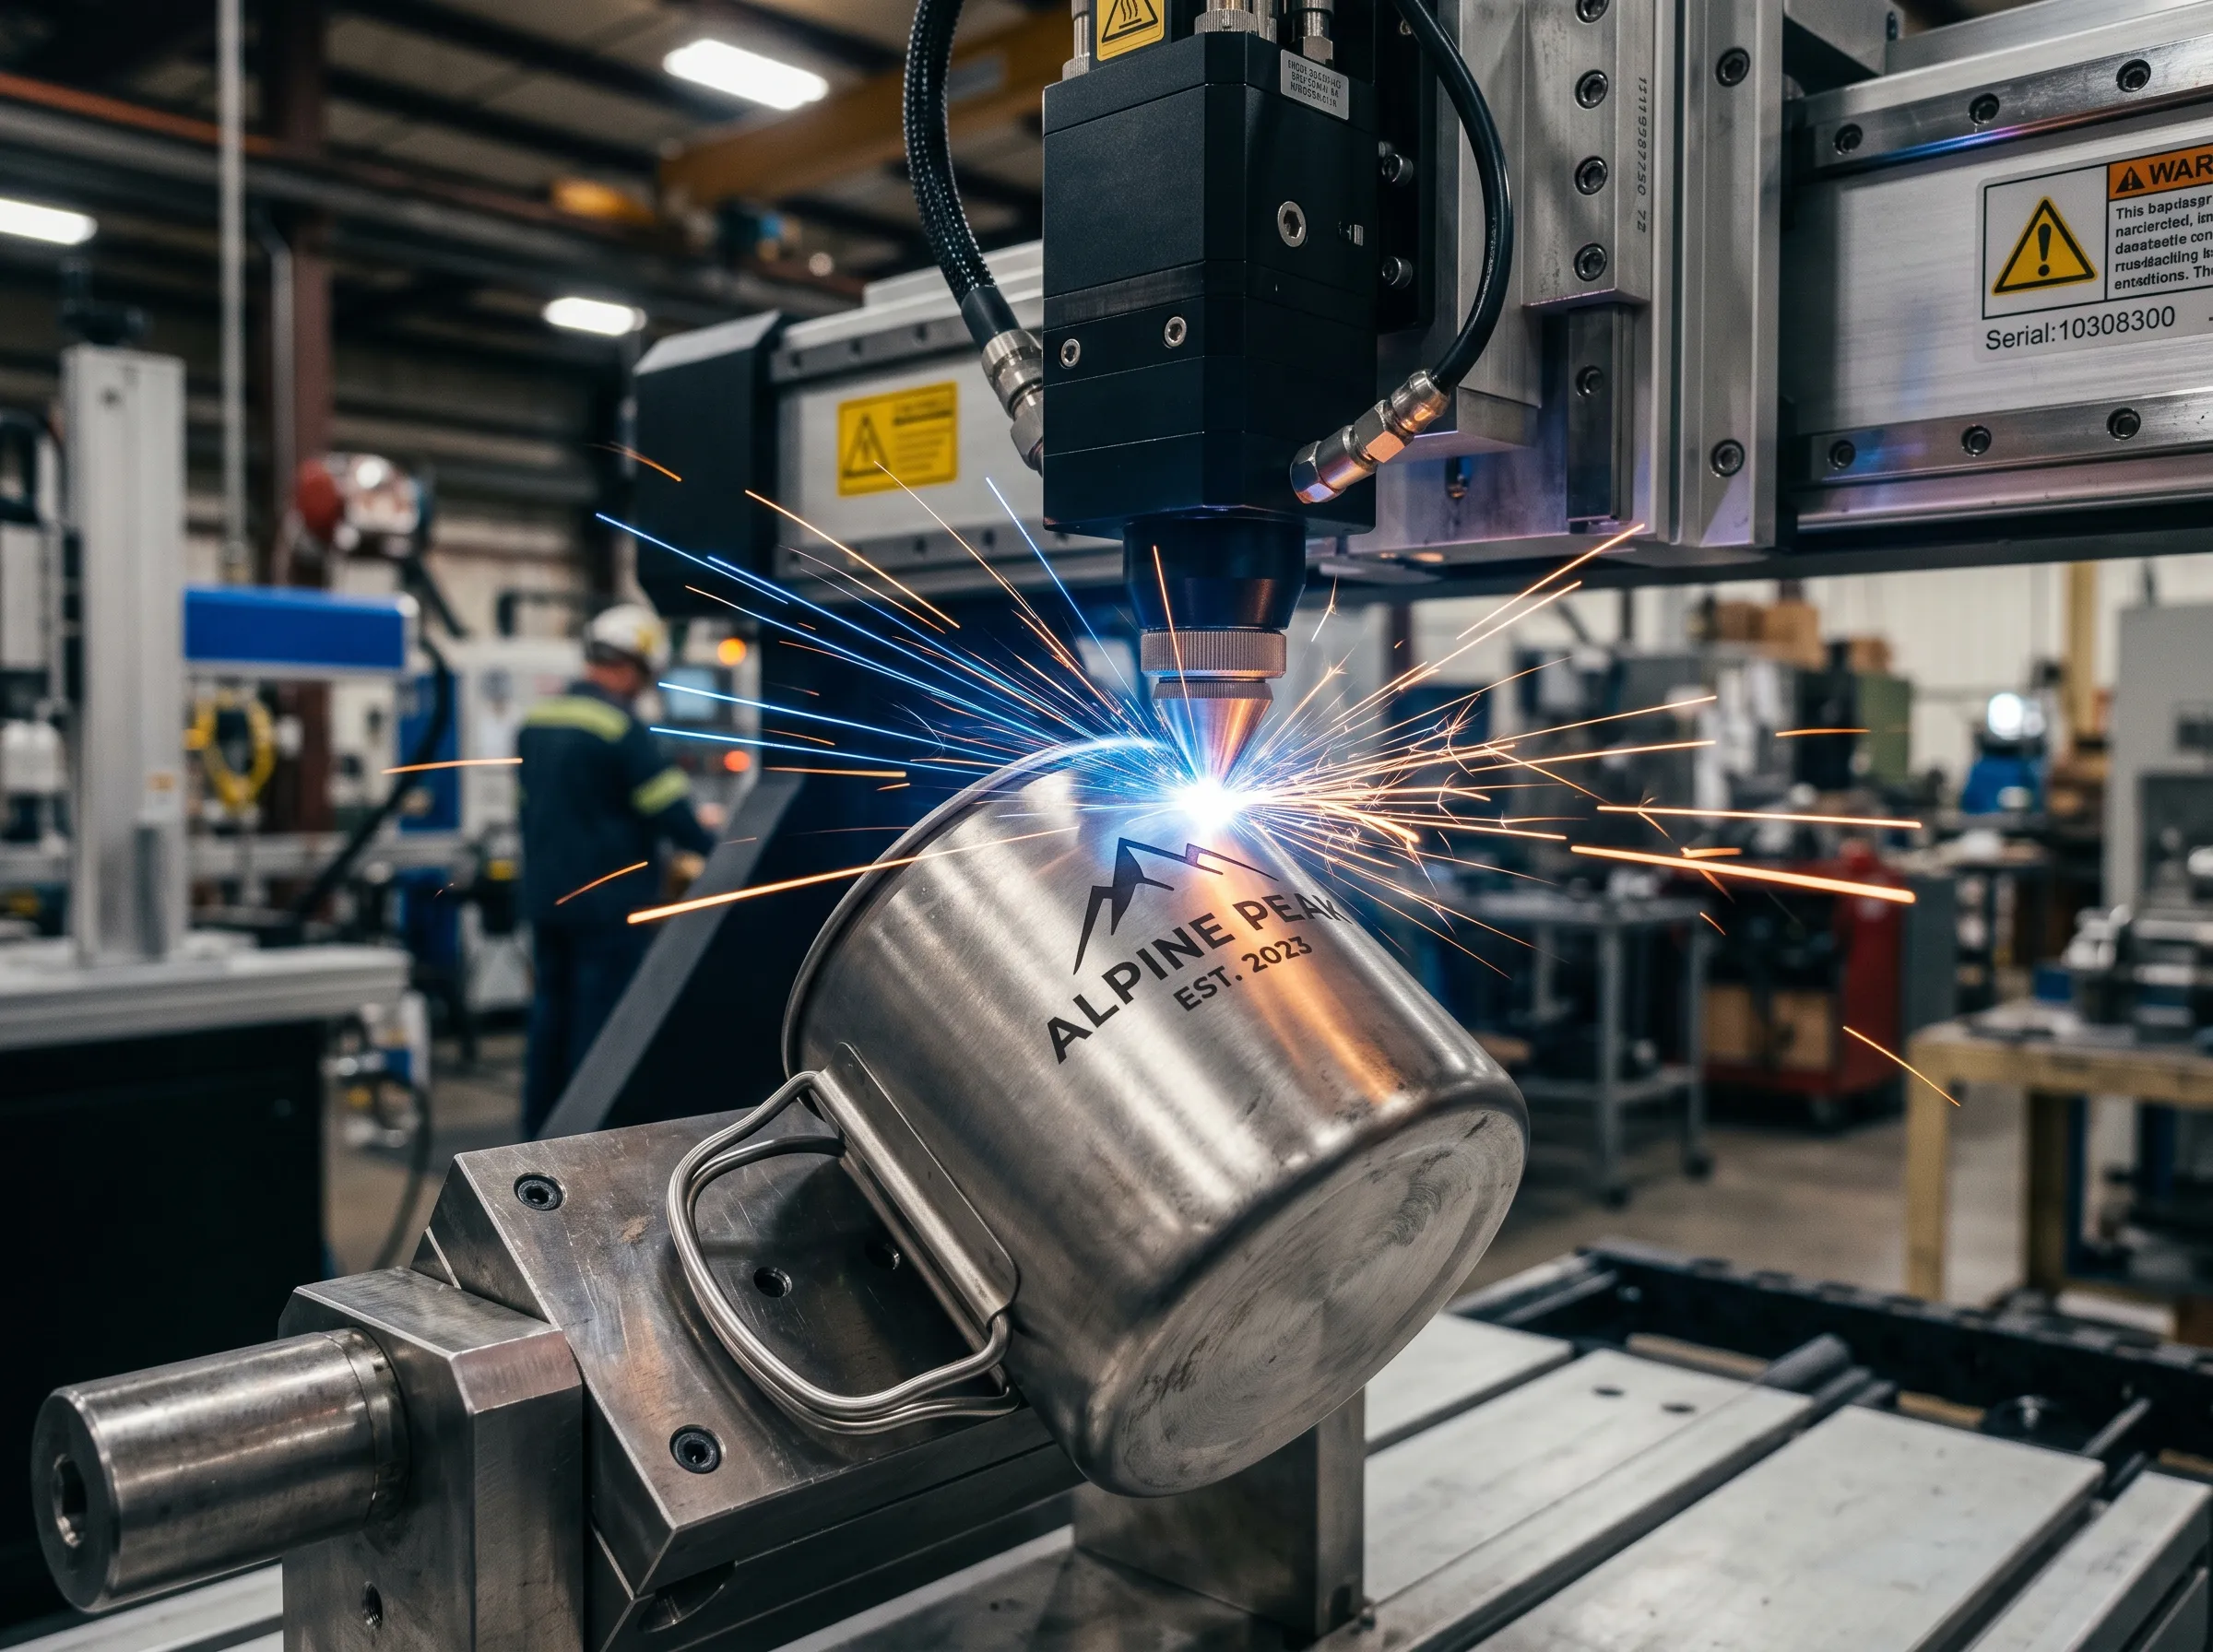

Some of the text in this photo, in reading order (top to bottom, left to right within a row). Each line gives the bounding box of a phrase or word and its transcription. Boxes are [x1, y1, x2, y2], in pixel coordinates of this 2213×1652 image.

[2115, 206, 2144, 219] This
[1985, 305, 2176, 350] Serial:10308300
[1047, 893, 1353, 1065] ALPINE PEAK
[1173, 936, 1313, 1012] EST. 2023
